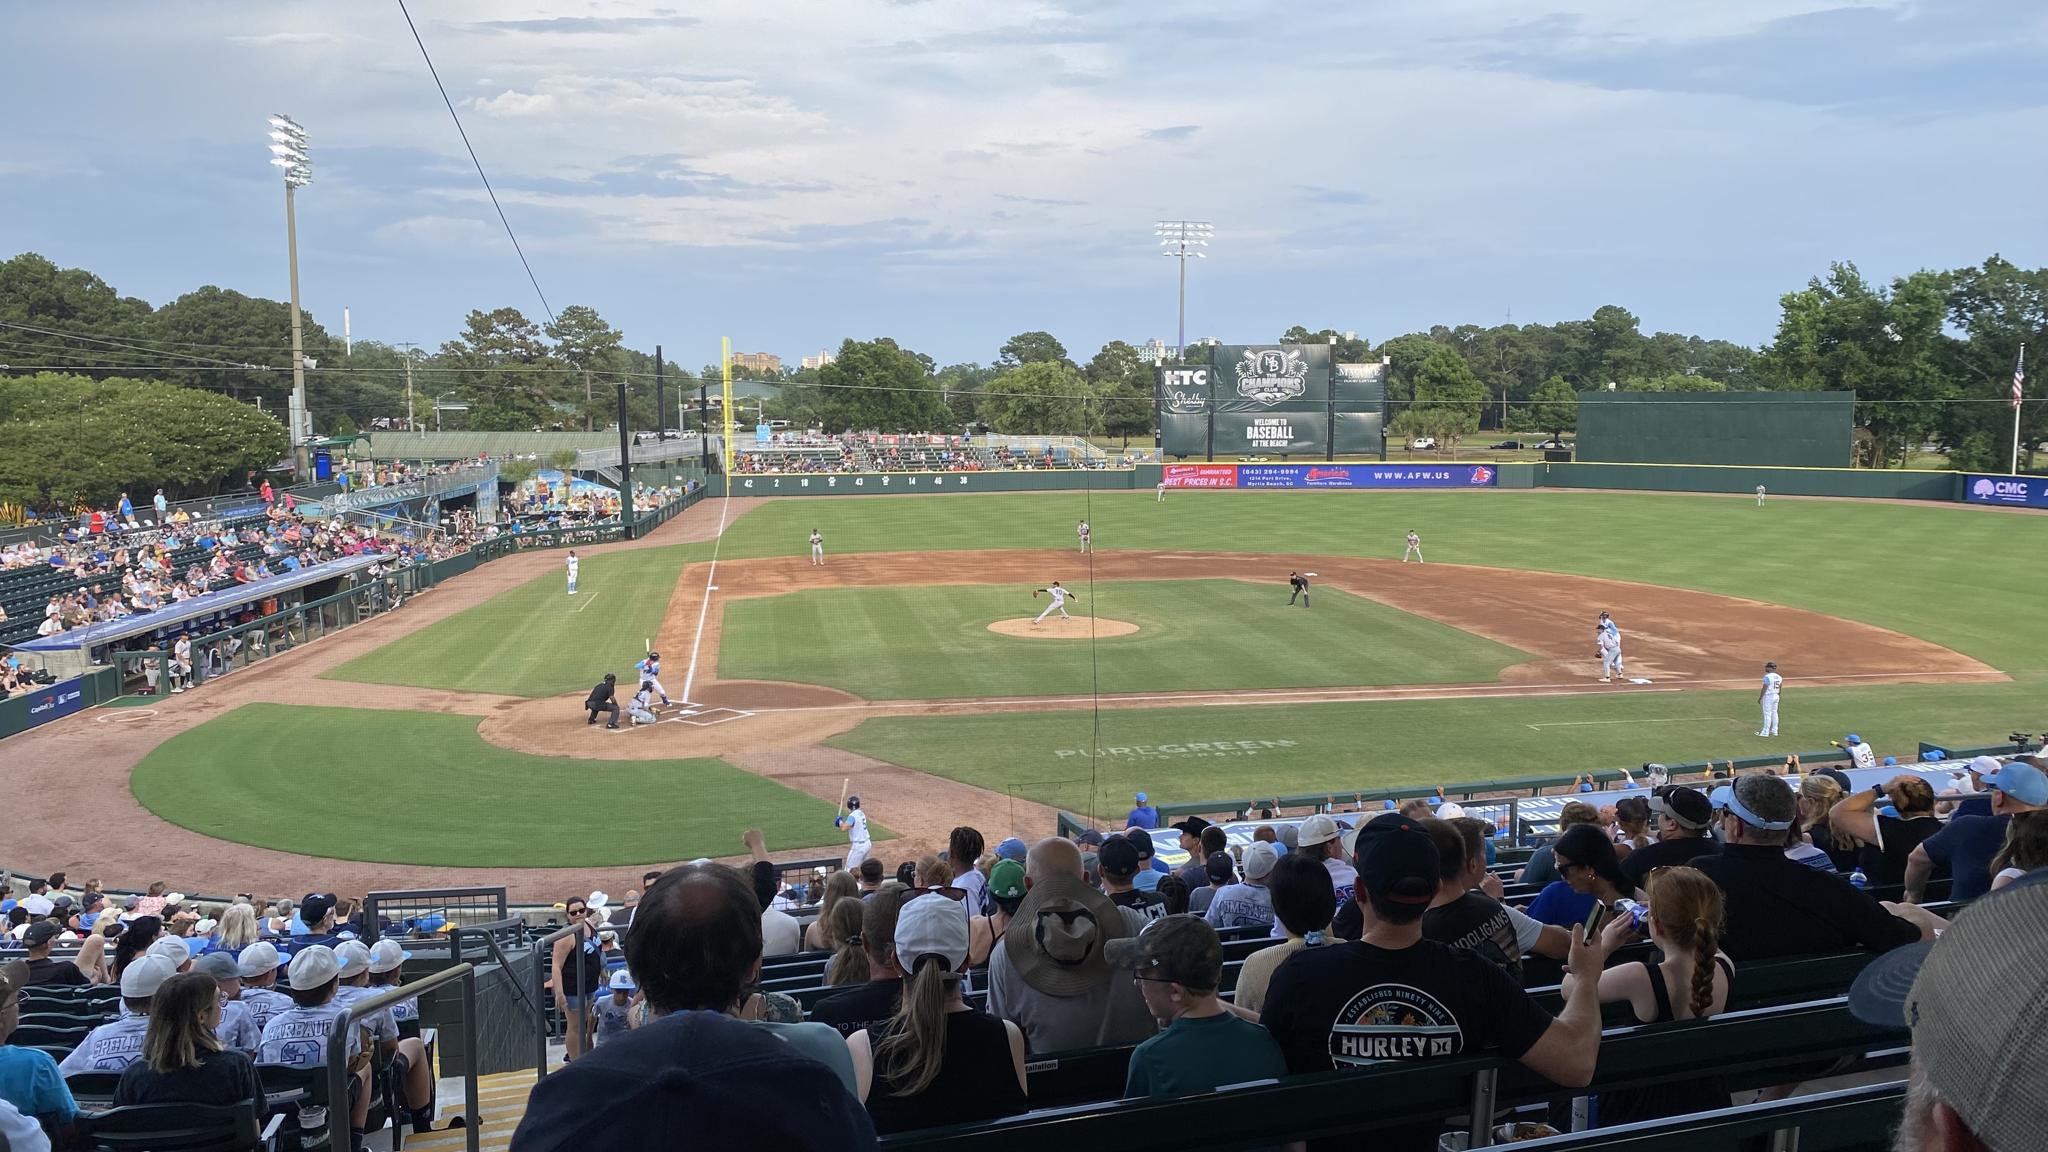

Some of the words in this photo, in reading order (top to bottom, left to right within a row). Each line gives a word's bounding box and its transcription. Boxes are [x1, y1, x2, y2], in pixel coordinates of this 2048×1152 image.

[1165, 370, 1207, 385] HTC
[1241, 377, 1301, 391] CHAMPIONS
[1172, 391, 1206, 407] Shelby
[1254, 418, 1279, 426] WELCOME
[1280, 418, 1288, 426] TO
[1246, 426, 1295, 439] BASEBALL
[1252, 439, 1259, 447] AT
[744, 479, 753, 488] 42
[774, 479, 779, 488] 2
[855, 477, 863, 486] 43
[908, 476, 916, 485] 14
[1164, 478, 1182, 486] BEST
[1184, 478, 1208, 486] PRICES
[1209, 478, 1218, 486] IN
[1995, 482, 2028, 494] CMC
[1773, 681, 1780, 689] 15
[1861, 751, 1874, 763] 35
[1346, 990, 1393, 1019] ESTABLISHED
[1396, 990, 1427, 1005] NINETY
[1427, 1003, 1446, 1020] NINE
[837, 1022, 849, 1030] TO
[851, 1021, 869, 1029] THE
[93, 1036, 145, 1058] SPELL
[1341, 1035, 1427, 1057] HURLEY
